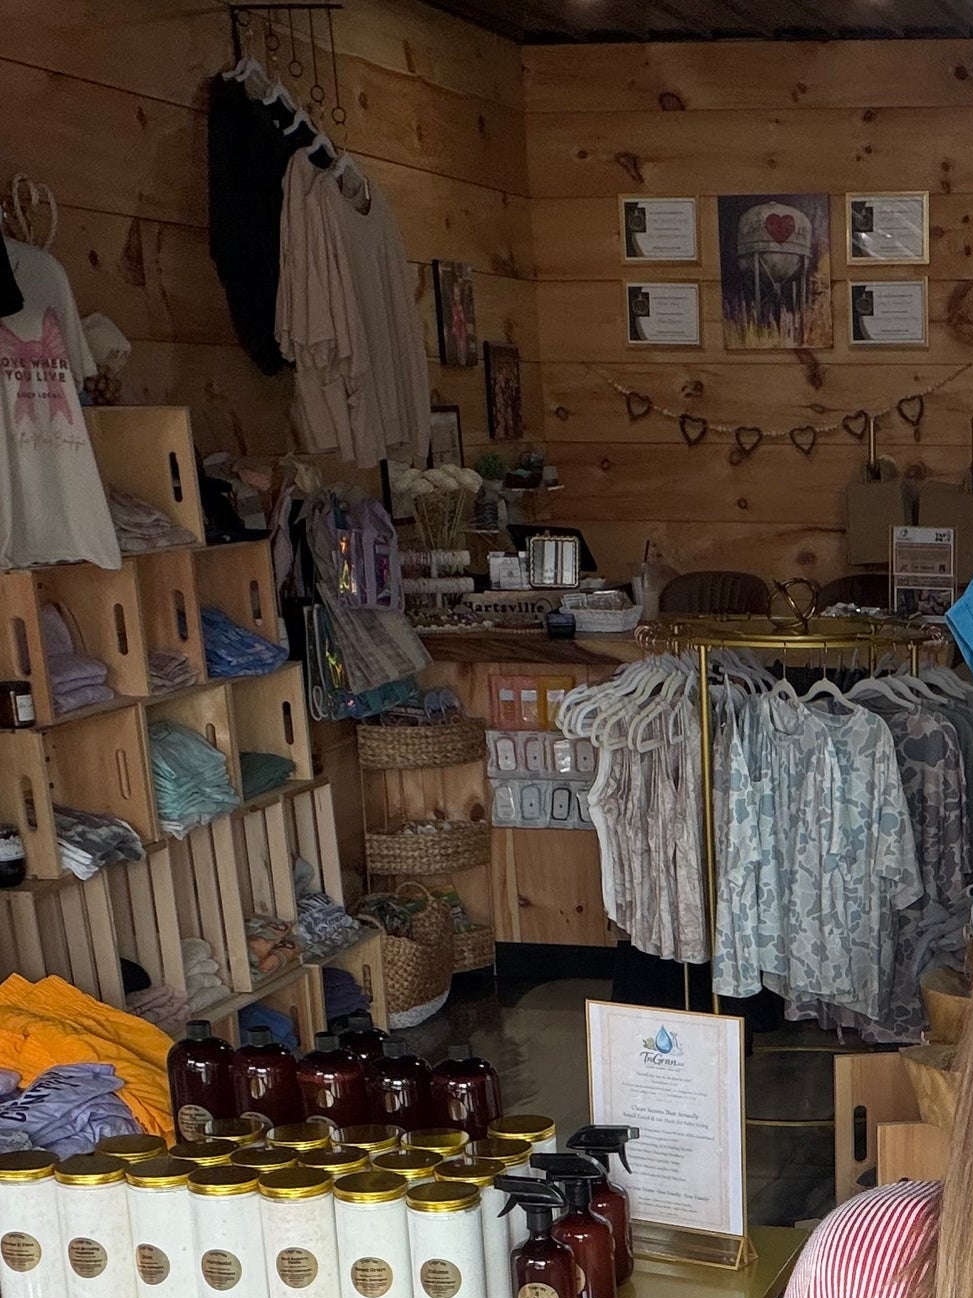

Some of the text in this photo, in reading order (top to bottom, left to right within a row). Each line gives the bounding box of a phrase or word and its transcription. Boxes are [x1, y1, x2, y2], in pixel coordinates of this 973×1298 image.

[1, 357, 68, 370] OVE WHER
[5, 370, 66, 383] YOU LIVE
[463, 601, 545, 614] Hartsville
